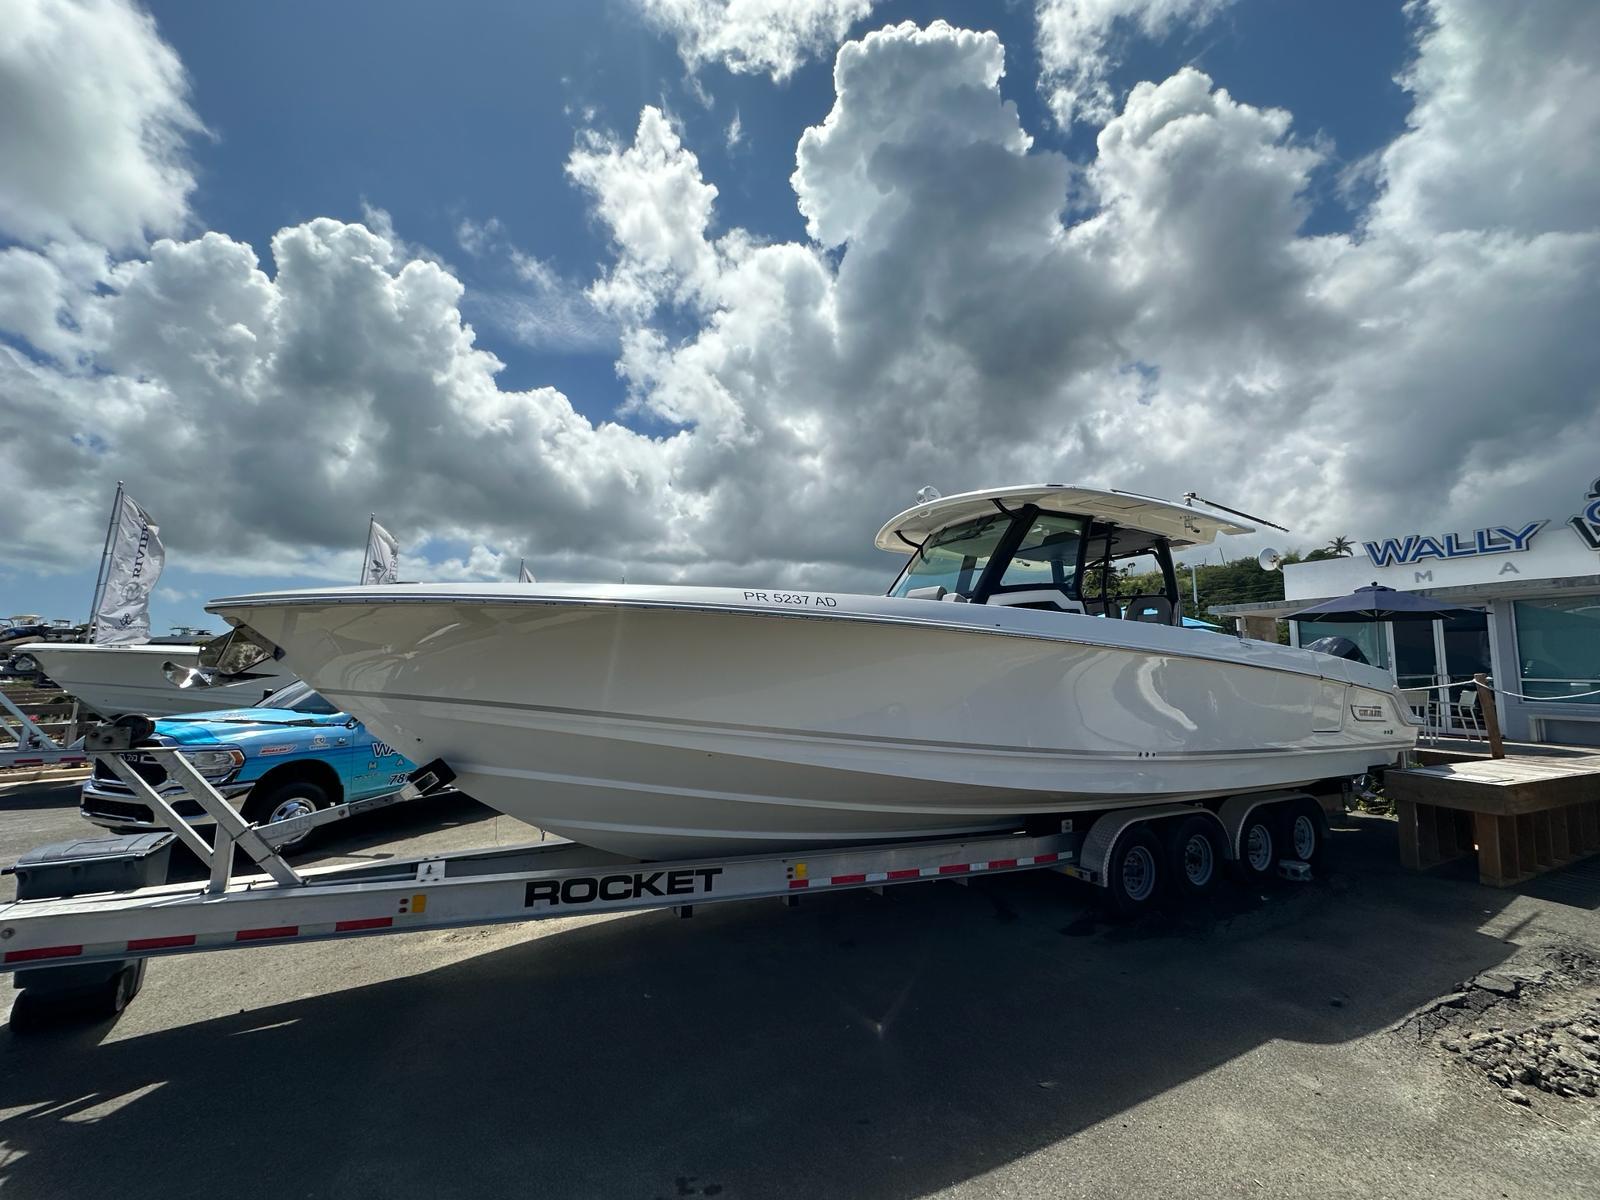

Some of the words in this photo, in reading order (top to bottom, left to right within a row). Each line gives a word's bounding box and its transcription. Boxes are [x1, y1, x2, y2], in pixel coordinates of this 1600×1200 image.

[1363, 520, 1547, 567] WALLY
[743, 591, 769, 602] PR
[773, 593, 809, 605] 5237
[815, 596, 837, 608] AD
[524, 867, 722, 907] ROCKET
